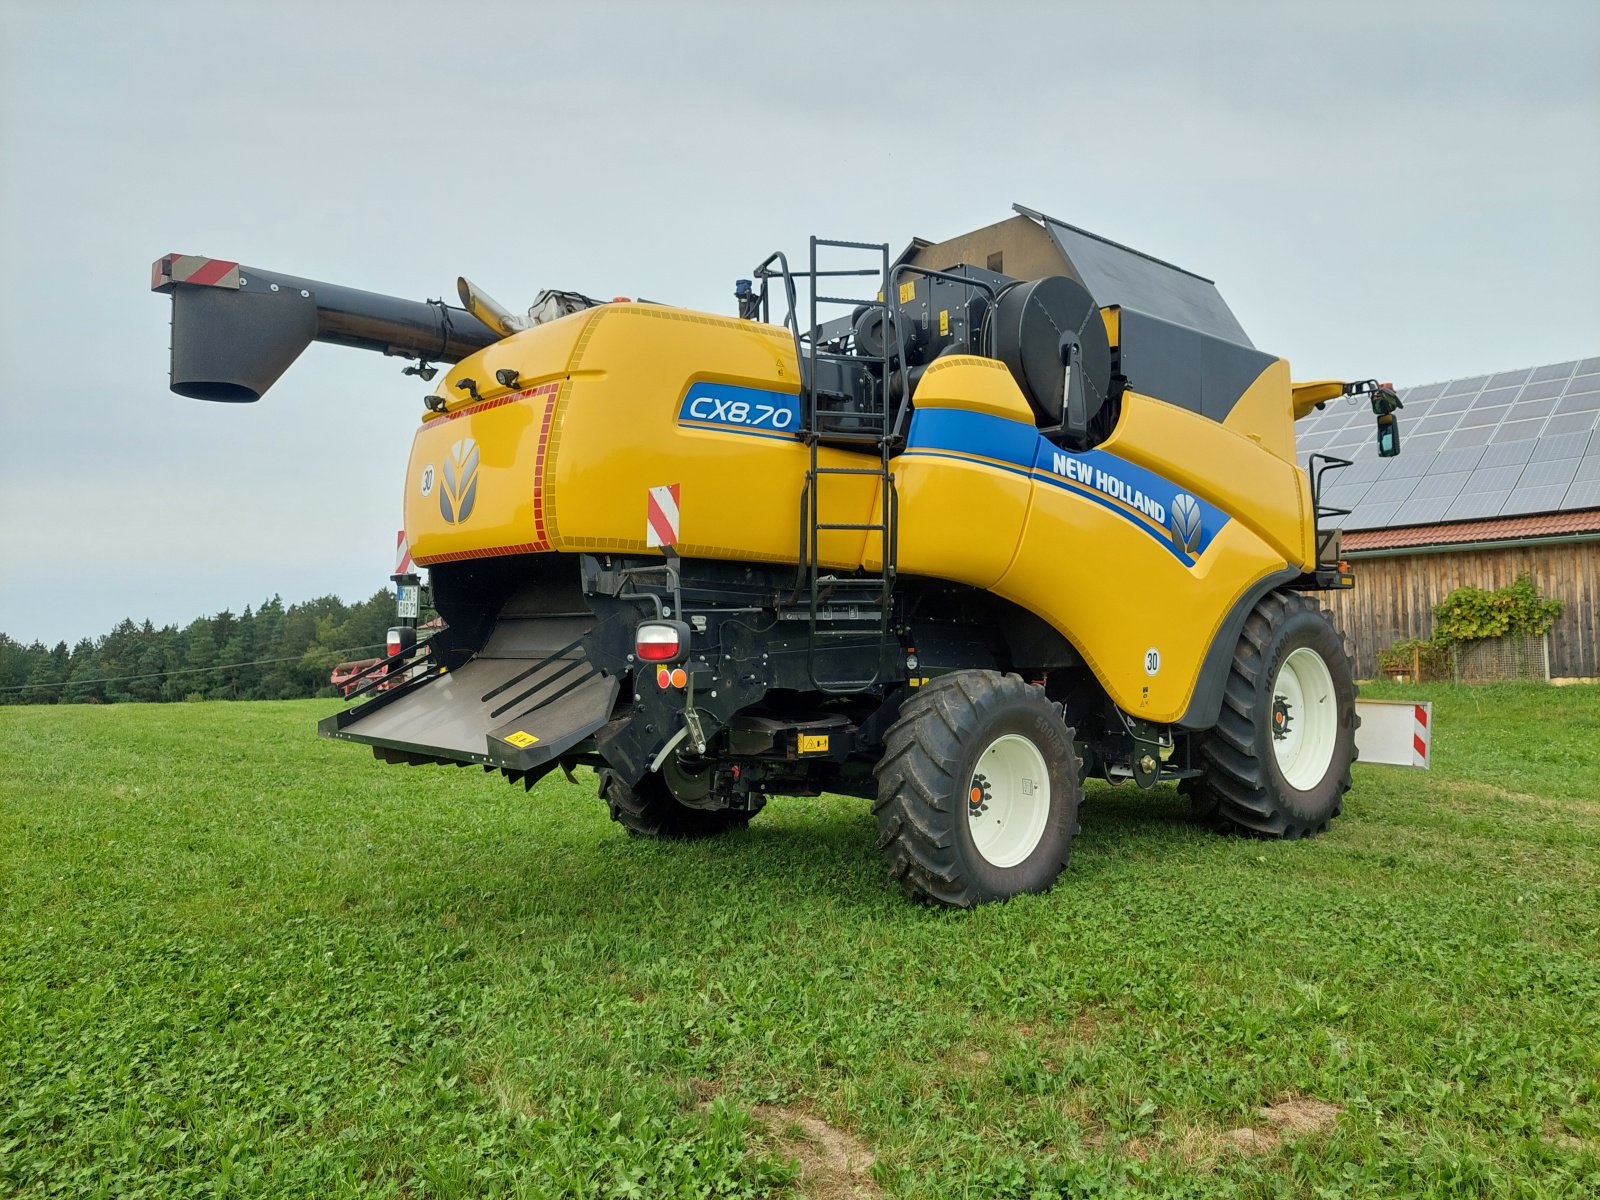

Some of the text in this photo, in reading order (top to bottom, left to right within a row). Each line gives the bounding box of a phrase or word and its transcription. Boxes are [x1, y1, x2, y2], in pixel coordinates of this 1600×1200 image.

[689, 397, 793, 428] CX8.70
[422, 469, 433, 492] 30
[1053, 452, 1166, 524] NEW HOLLAND
[1147, 652, 1158, 671] 30
